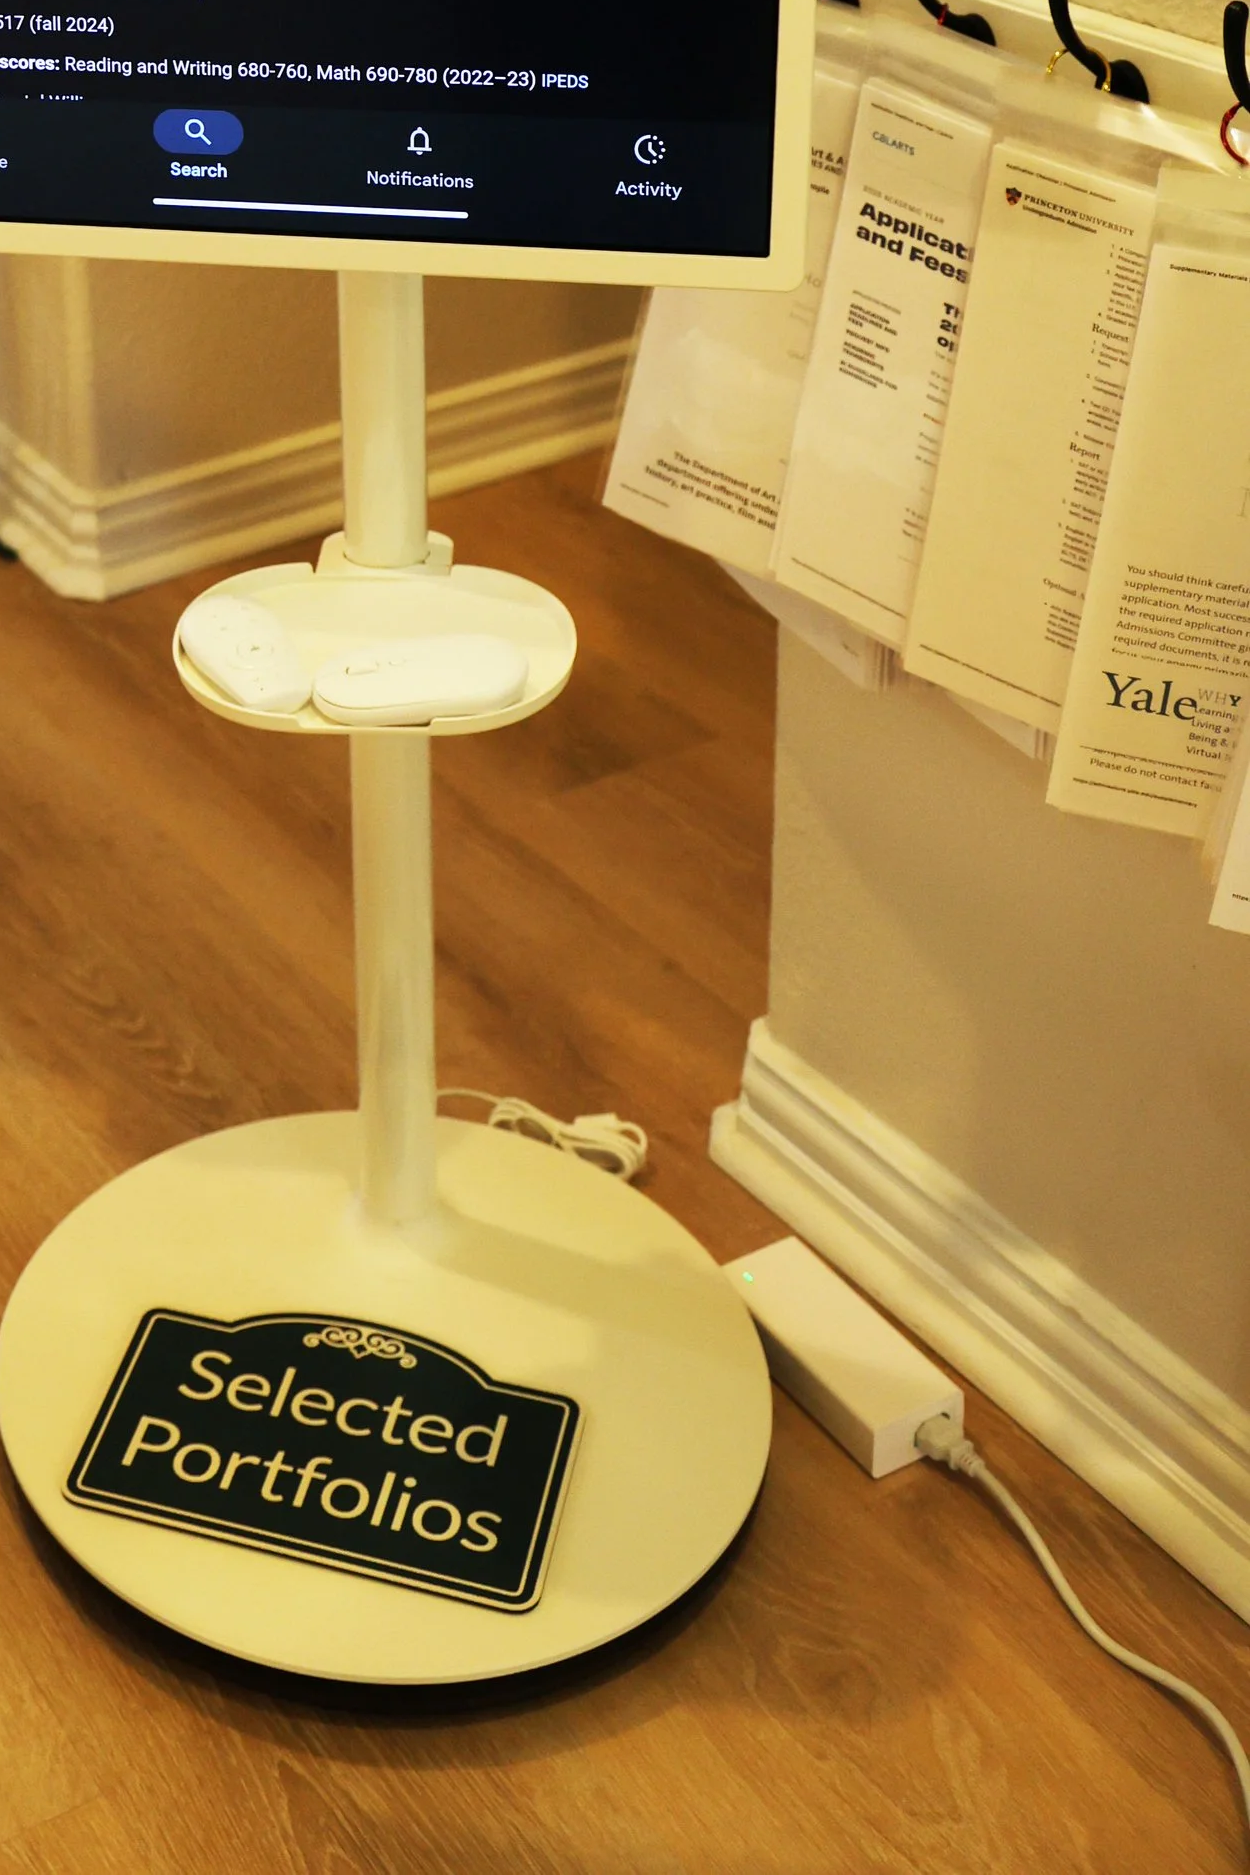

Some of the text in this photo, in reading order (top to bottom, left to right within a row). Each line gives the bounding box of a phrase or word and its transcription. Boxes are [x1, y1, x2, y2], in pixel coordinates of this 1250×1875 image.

[29, 14, 62, 35] (fall
[65, 16, 115, 37] 2024)
[170, 161, 228, 178] Search
[366, 170, 474, 189] Notifications
[615, 180, 683, 201] Activity
[1024, 194, 1135, 236] PRINCETON UNIVERSITY
[856, 225, 970, 284] and Fees
[1128, 564, 1146, 575] You
[1148, 569, 1184, 583] should
[1186, 575, 1213, 587] think
[1124, 580, 1203, 601] supplementary
[1121, 593, 1180, 611] application.
[1184, 604, 1211, 617] Most
[1119, 606, 1243, 637] the required application
[1116, 620, 1236, 650] Admissions Committee
[1114, 635, 1156, 649] required
[1222, 654, 1229, 663] it
[1232, 656, 1240, 665] is
[1102, 671, 1197, 721] Yale
[1189, 732, 1218, 747] Being
[1186, 746, 1221, 760] Virtual
[1090, 758, 1197, 787] Please do not contact
[177, 1350, 509, 1468] Selected
[120, 1414, 503, 1553] Portfolios
